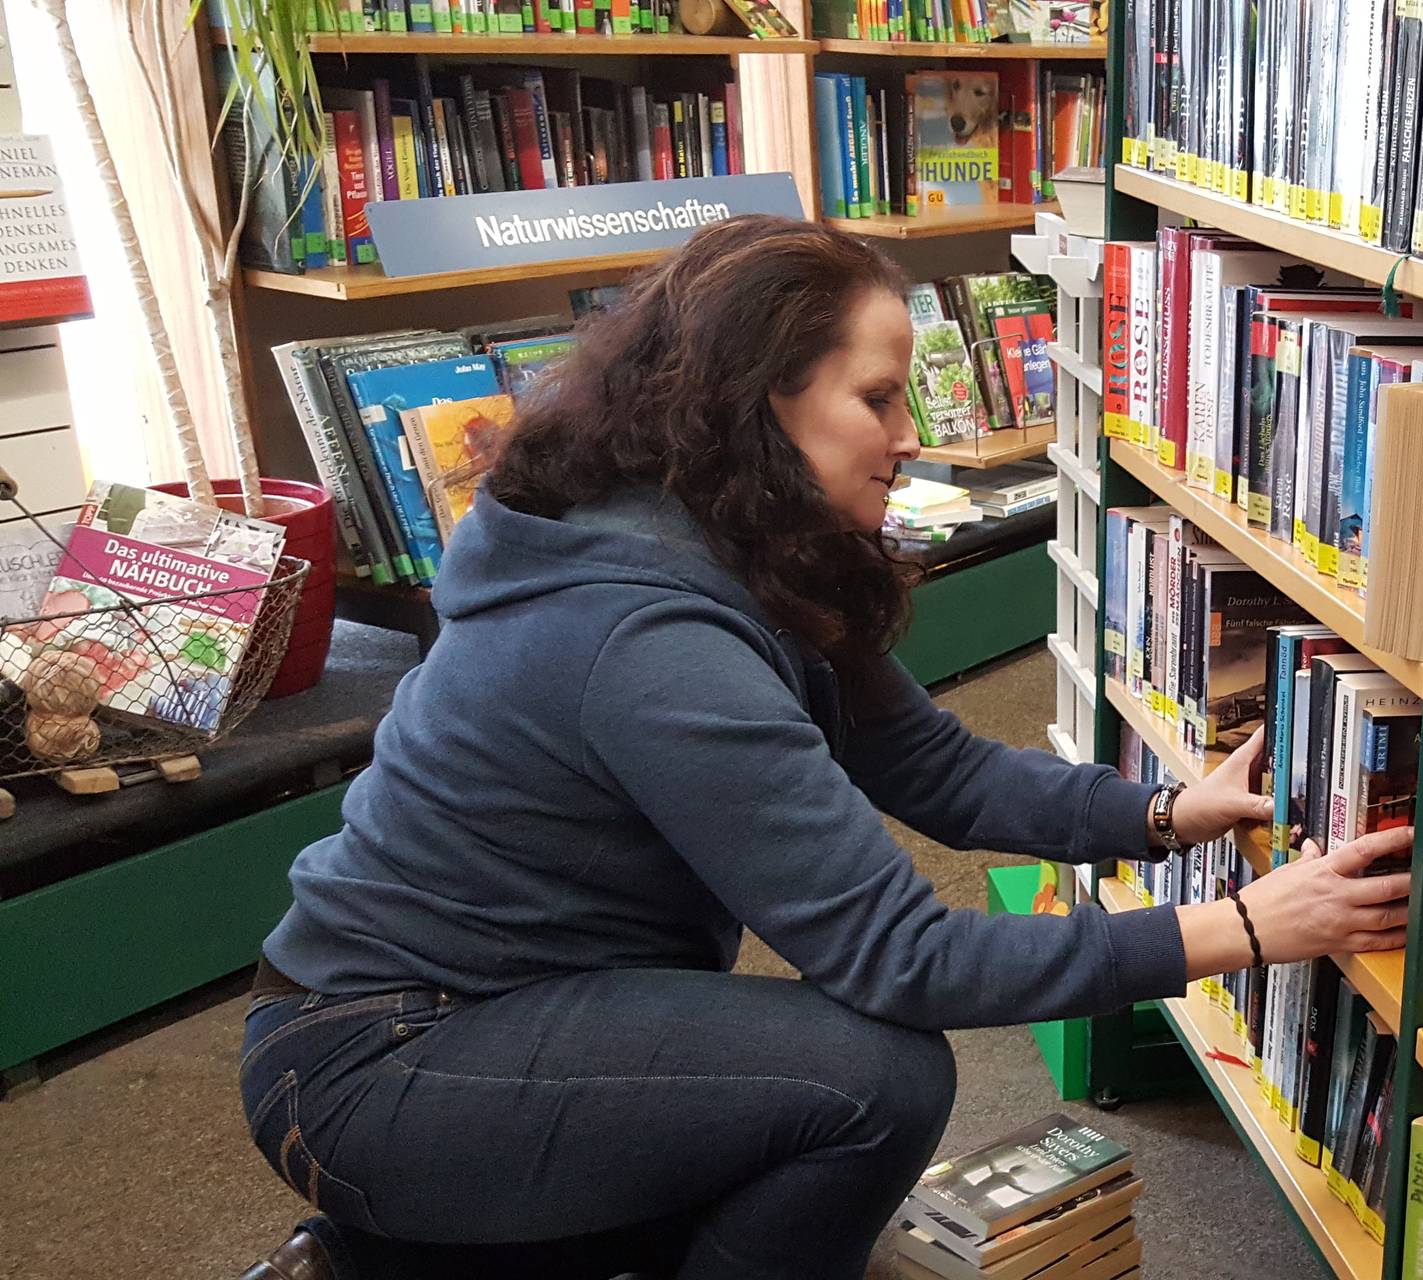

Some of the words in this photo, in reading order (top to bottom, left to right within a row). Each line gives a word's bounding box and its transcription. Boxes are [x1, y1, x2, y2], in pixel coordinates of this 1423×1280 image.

[1406, 78, 1416, 113] HERZEN
[858, 120, 868, 166] ANGLER
[1402, 115, 1412, 163] FALSCHE
[927, 161, 993, 183] HUNDE
[928, 192, 944, 203] GU
[475, 199, 731, 247] Naturwissenschaften
[5, 257, 69, 274] DENKEN
[1133, 296, 1150, 404] ROSE
[104, 539, 138, 560] Das
[140, 549, 230, 585] ultimative
[109, 558, 213, 596] NÄHBUCH
[1227, 596, 1270, 607] Dorothy
[1225, 618, 1245, 628] Fünf
[1280, 645, 1288, 680] Tannöd
[1365, 697, 1422, 706] HEINZ
[1376, 726, 1388, 772] KRIMI
[1040, 1137, 1080, 1160] Sayers
[1047, 1127, 1100, 1158] Dorothy
